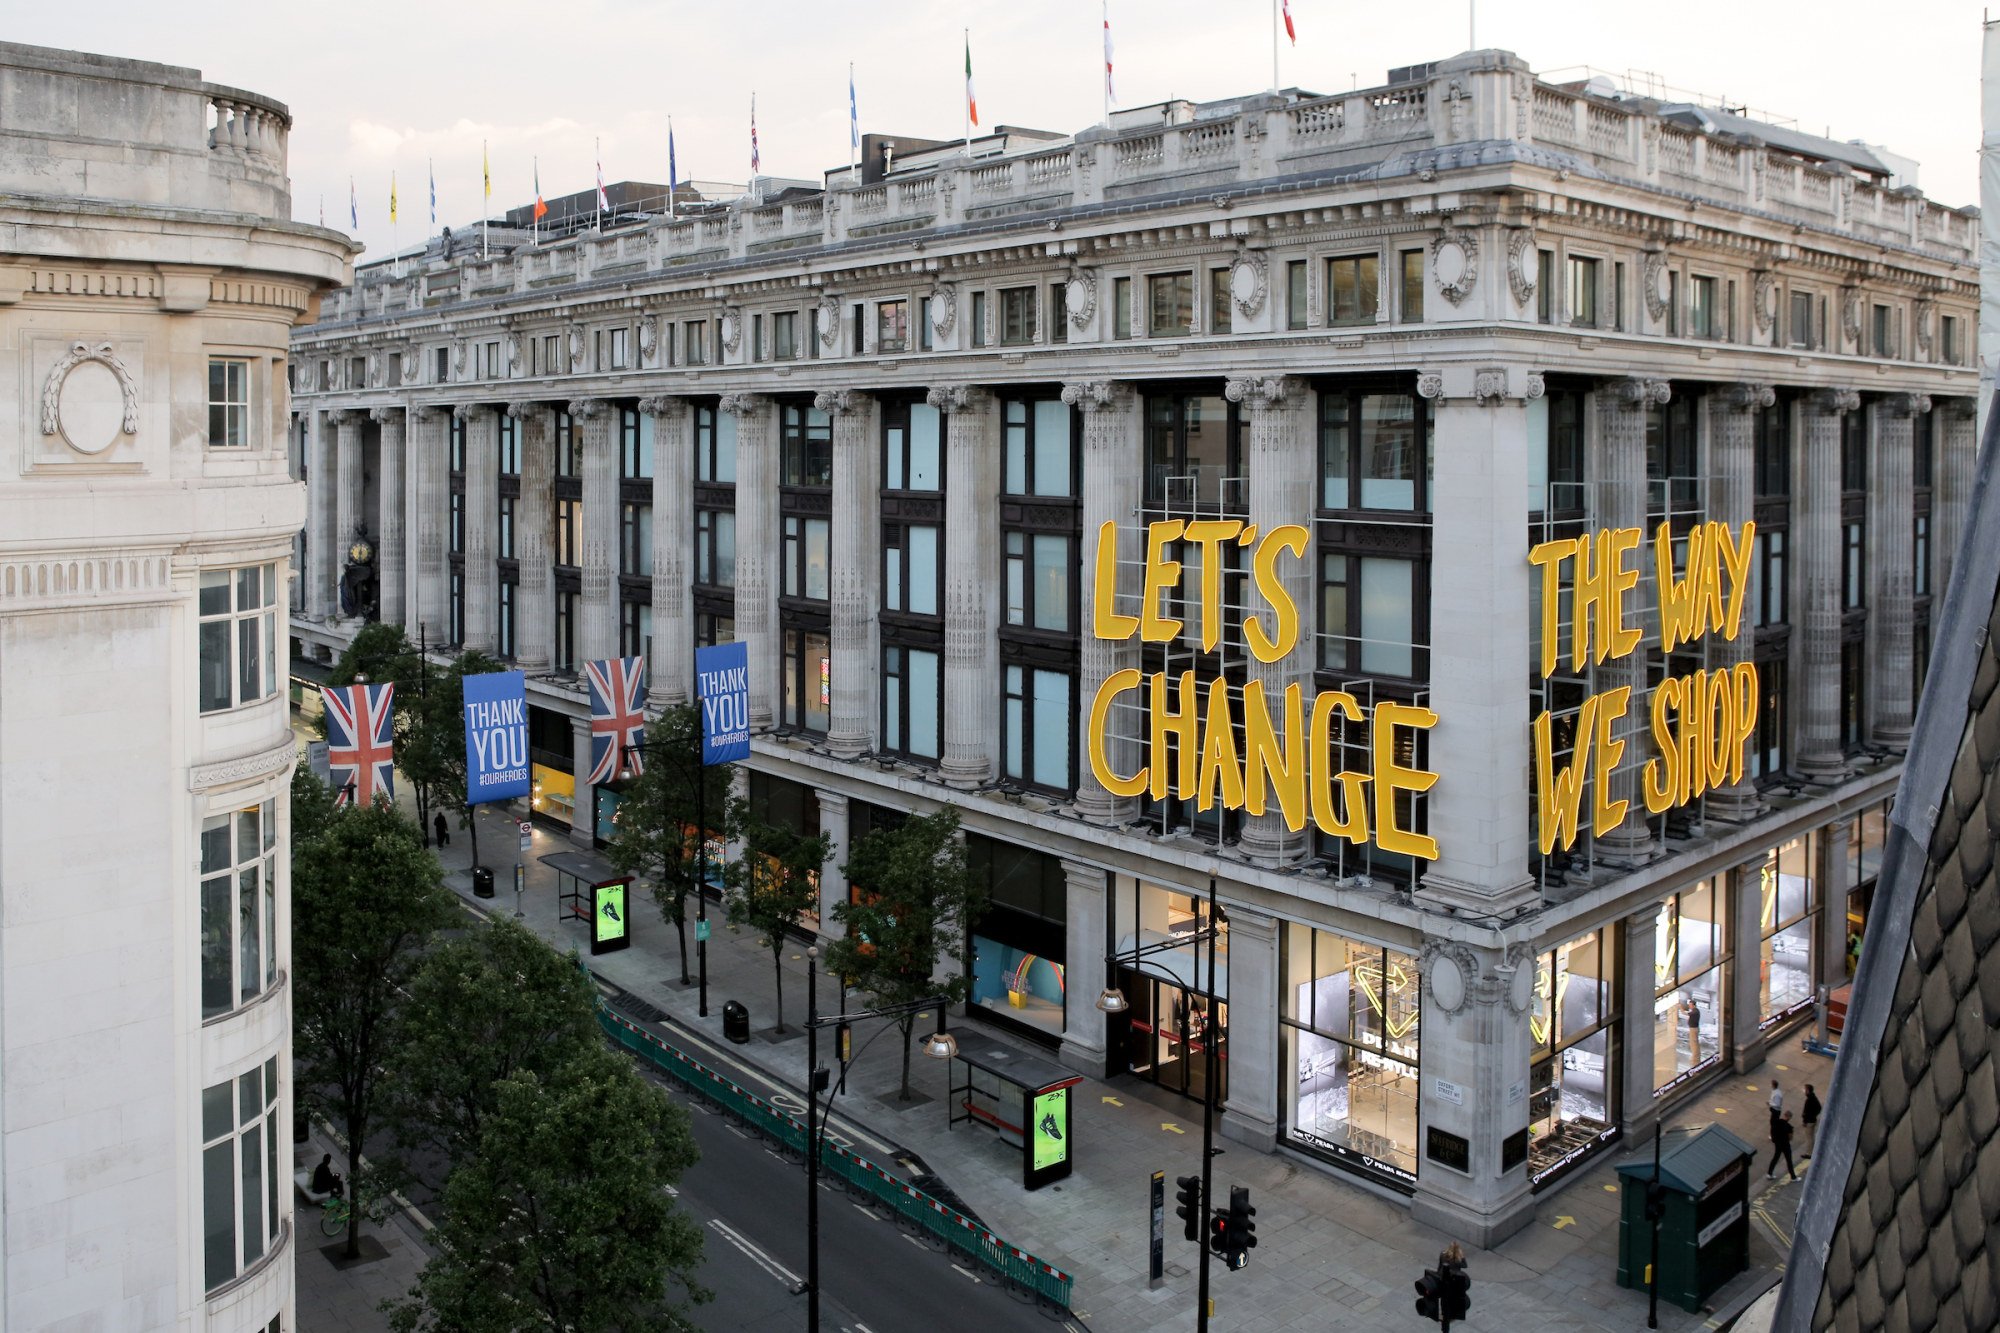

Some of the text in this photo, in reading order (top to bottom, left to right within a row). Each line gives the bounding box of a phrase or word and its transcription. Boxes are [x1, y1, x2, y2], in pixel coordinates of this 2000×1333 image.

[1093, 519, 1310, 664] LET'S
[1527, 520, 1756, 680] THE WAY
[699, 666, 747, 697] THANK
[466, 697, 524, 730] THANK
[703, 691, 748, 735] YOU
[471, 725, 527, 772] YOU
[710, 730, 749, 748] #OURHEROES
[479, 768, 528, 787] #OURHEROES
[1088, 668, 1440, 862] CHANGE
[1534, 662, 1759, 855] WE SHOP
[1437, 1080, 1455, 1091] OXFORD
[1437, 1086, 1453, 1096] STREET
